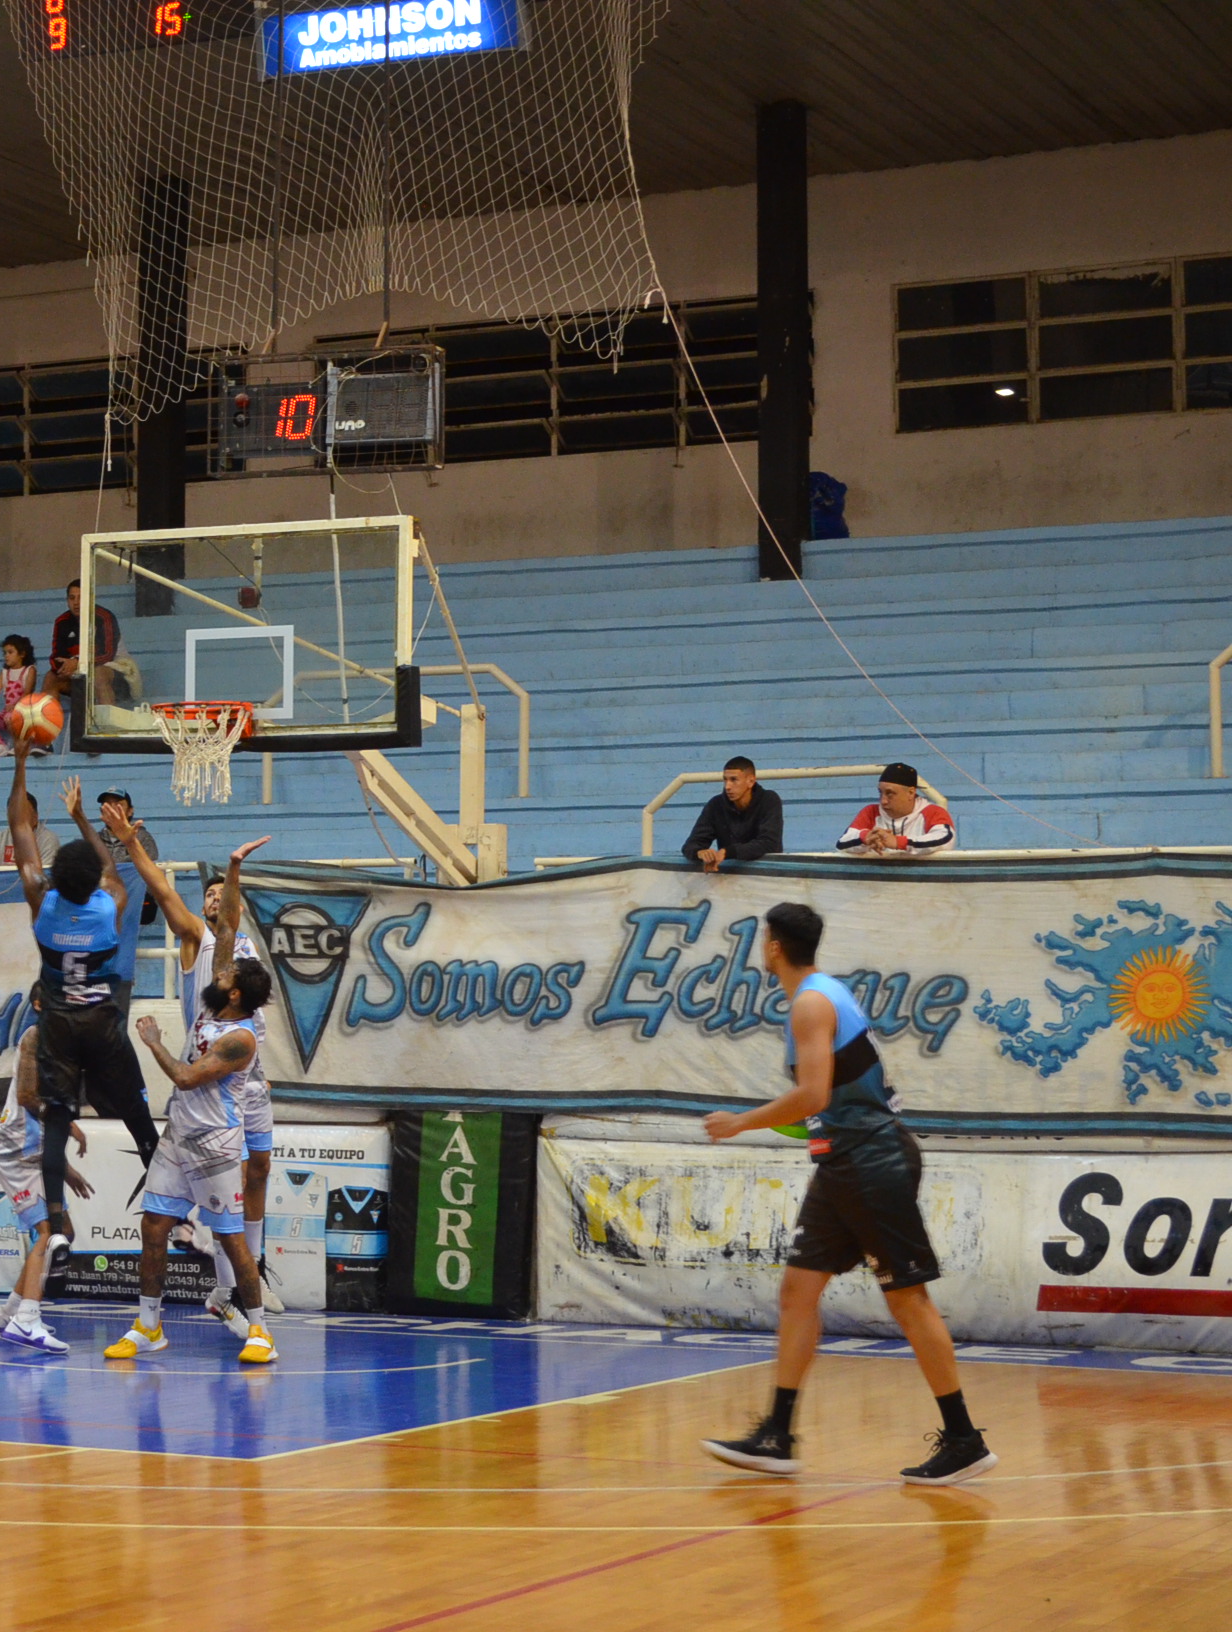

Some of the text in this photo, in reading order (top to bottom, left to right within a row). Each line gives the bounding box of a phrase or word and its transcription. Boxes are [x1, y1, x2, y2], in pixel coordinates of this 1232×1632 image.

[49, 17, 67, 50] 9
[298, 0, 482, 46] JOHNSON
[299, 31, 482, 68] Amoblamientos
[275, 394, 316, 440] 10
[270, 926, 345, 955] AEC
[346, 902, 585, 1027] Somos
[288, 1147, 297, 1158] A
[299, 1148, 316, 1159] TU
[319, 1148, 365, 1161] EQUIPO
[1042, 1172, 1232, 1277] Sor
[166, 1262, 200, 1273] 341130
